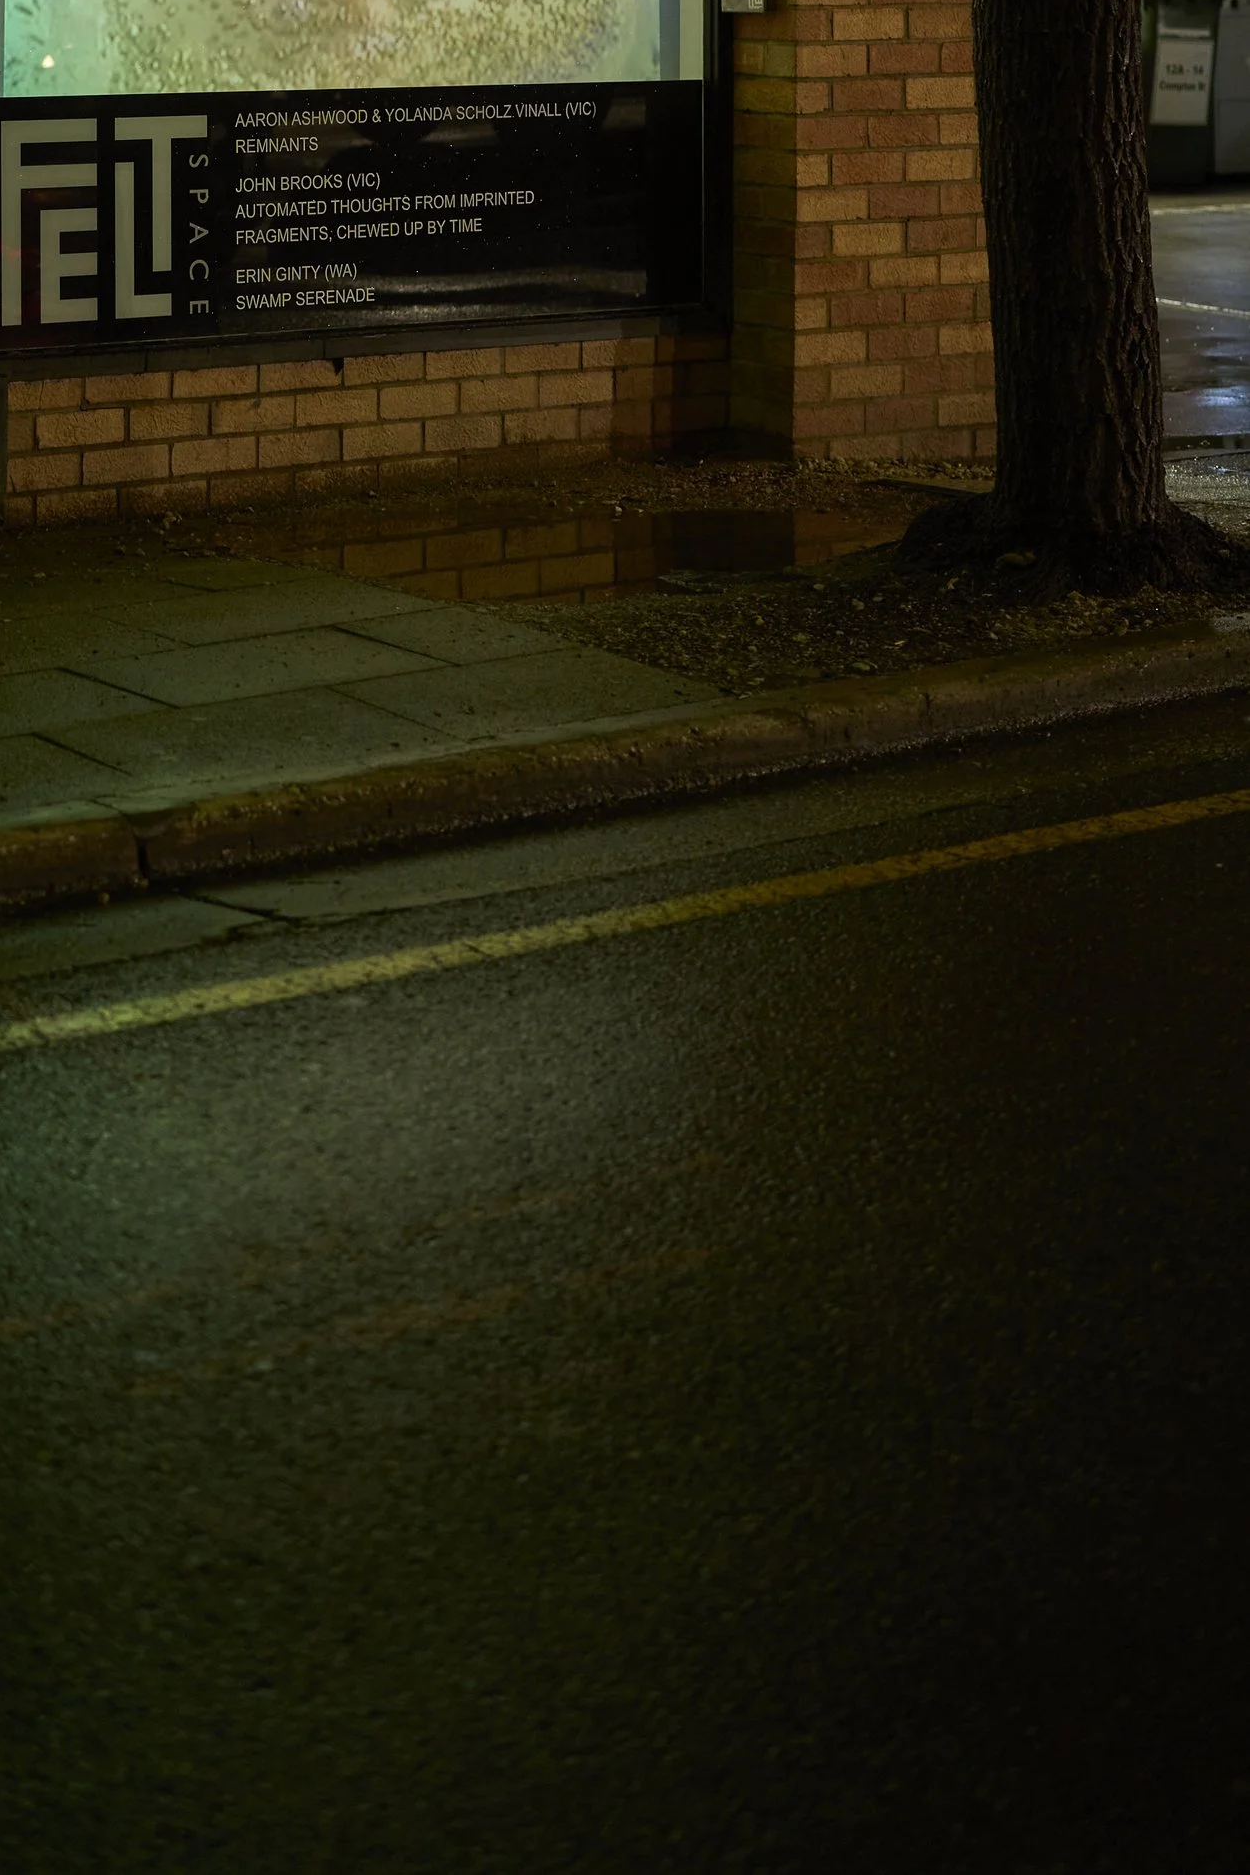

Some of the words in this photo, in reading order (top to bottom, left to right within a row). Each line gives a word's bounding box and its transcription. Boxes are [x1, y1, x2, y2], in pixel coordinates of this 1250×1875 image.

[235, 111, 288, 128] AARON
[291, 109, 368, 126] ASHWOOD
[371, 110, 382, 124] &
[385, 106, 452, 123] YOLANDA
[456, 104, 512, 121] SCHOLZ
[515, 102, 561, 119] VINALL
[565, 101, 597, 120] (VIC)
[235, 137, 319, 154] REMNANTS
[235, 176, 276, 193] JOHN
[280, 174, 343, 192] BROOKS
[346, 172, 381, 192] (VIC)
[235, 202, 327, 220] AUTOMATED
[331, 197, 410, 215] THOUGHTS
[414, 193, 456, 210] FROM
[459, 190, 535, 208] IMPRINTED
[1, 115, 208, 327] FELT
[188, 153, 210, 315] SPACE
[235, 227, 333, 245] FRAGMENTS,
[336, 222, 400, 240] CHEWED
[404, 220, 423, 236] UP
[428, 219, 446, 235] BY
[449, 217, 483, 234] TIME
[235, 268, 272, 284] ERIN
[275, 265, 320, 282] GINTY
[324, 263, 358, 282] (WA)
[235, 292, 292, 310] SWAMP
[295, 287, 375, 306] SERENADE
